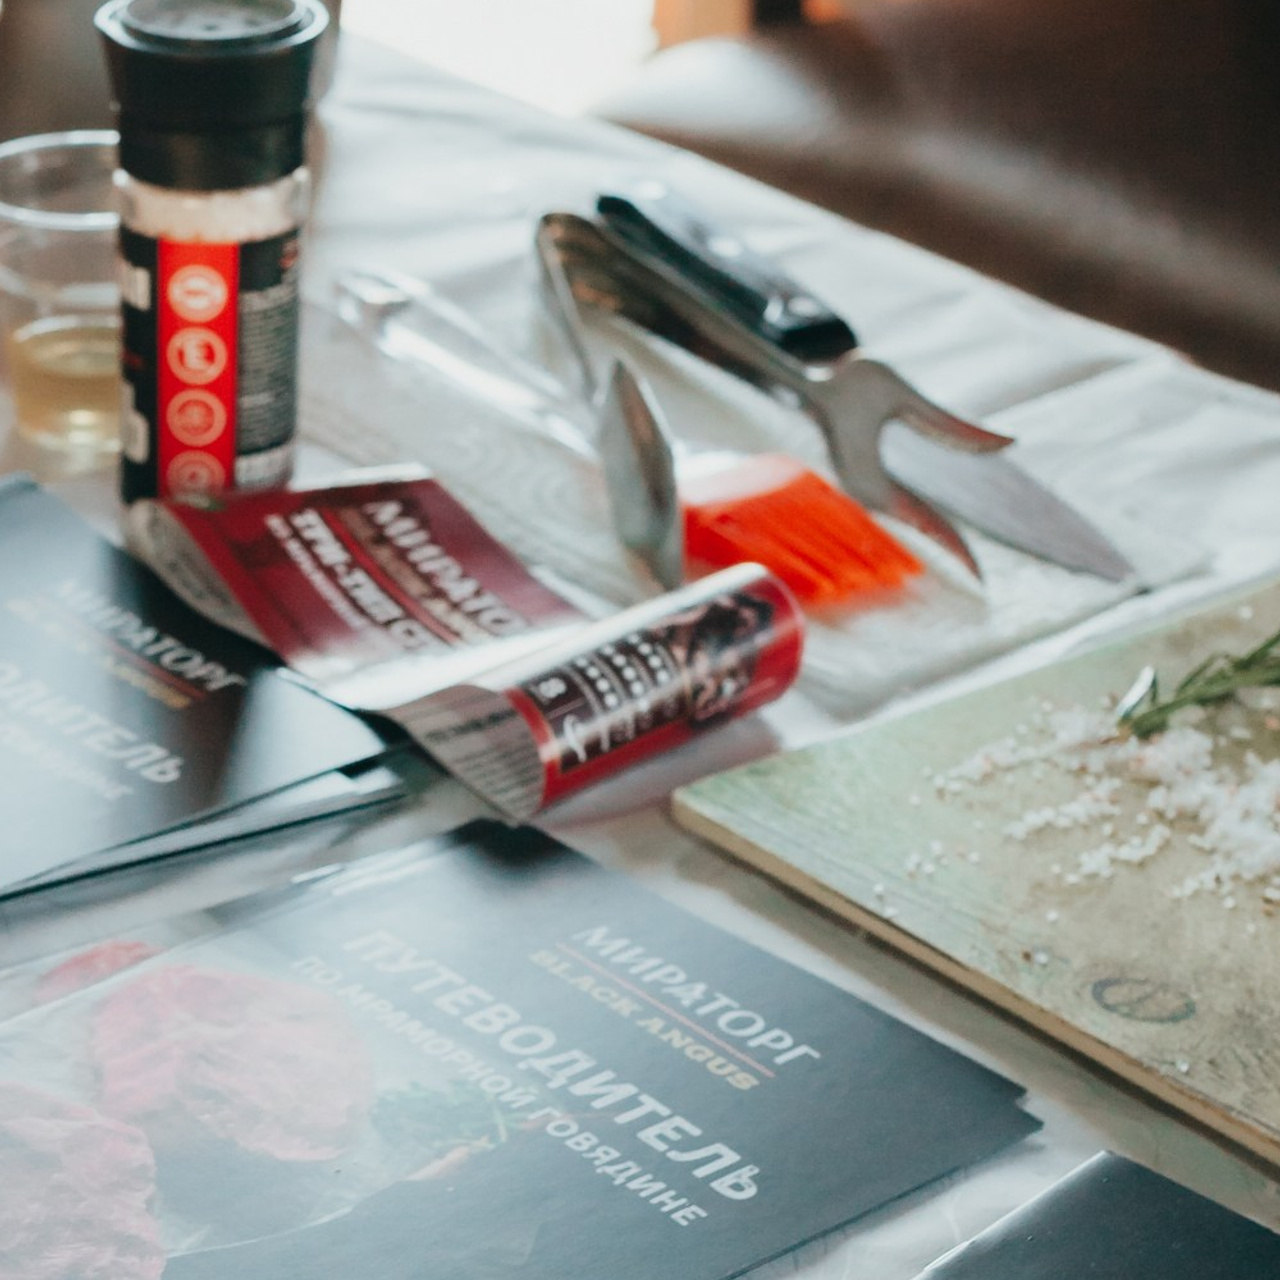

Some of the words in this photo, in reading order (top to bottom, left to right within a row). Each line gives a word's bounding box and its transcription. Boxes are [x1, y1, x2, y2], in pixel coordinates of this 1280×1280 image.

[362, 501, 526, 637] МИРАТО
[343, 929, 759, 1201] ПУТЕВОДИТЕЛЬ
[528, 949, 645, 1018] BLACK
[637, 1012, 759, 1091] ANGUS
[572, 925, 820, 1066] МИРАТОРГ
[292, 956, 343, 988] ПО
[350, 981, 538, 1110] МРАМОРНОЙ
[528, 1107, 708, 1228] ГОВЯДИНЕ
